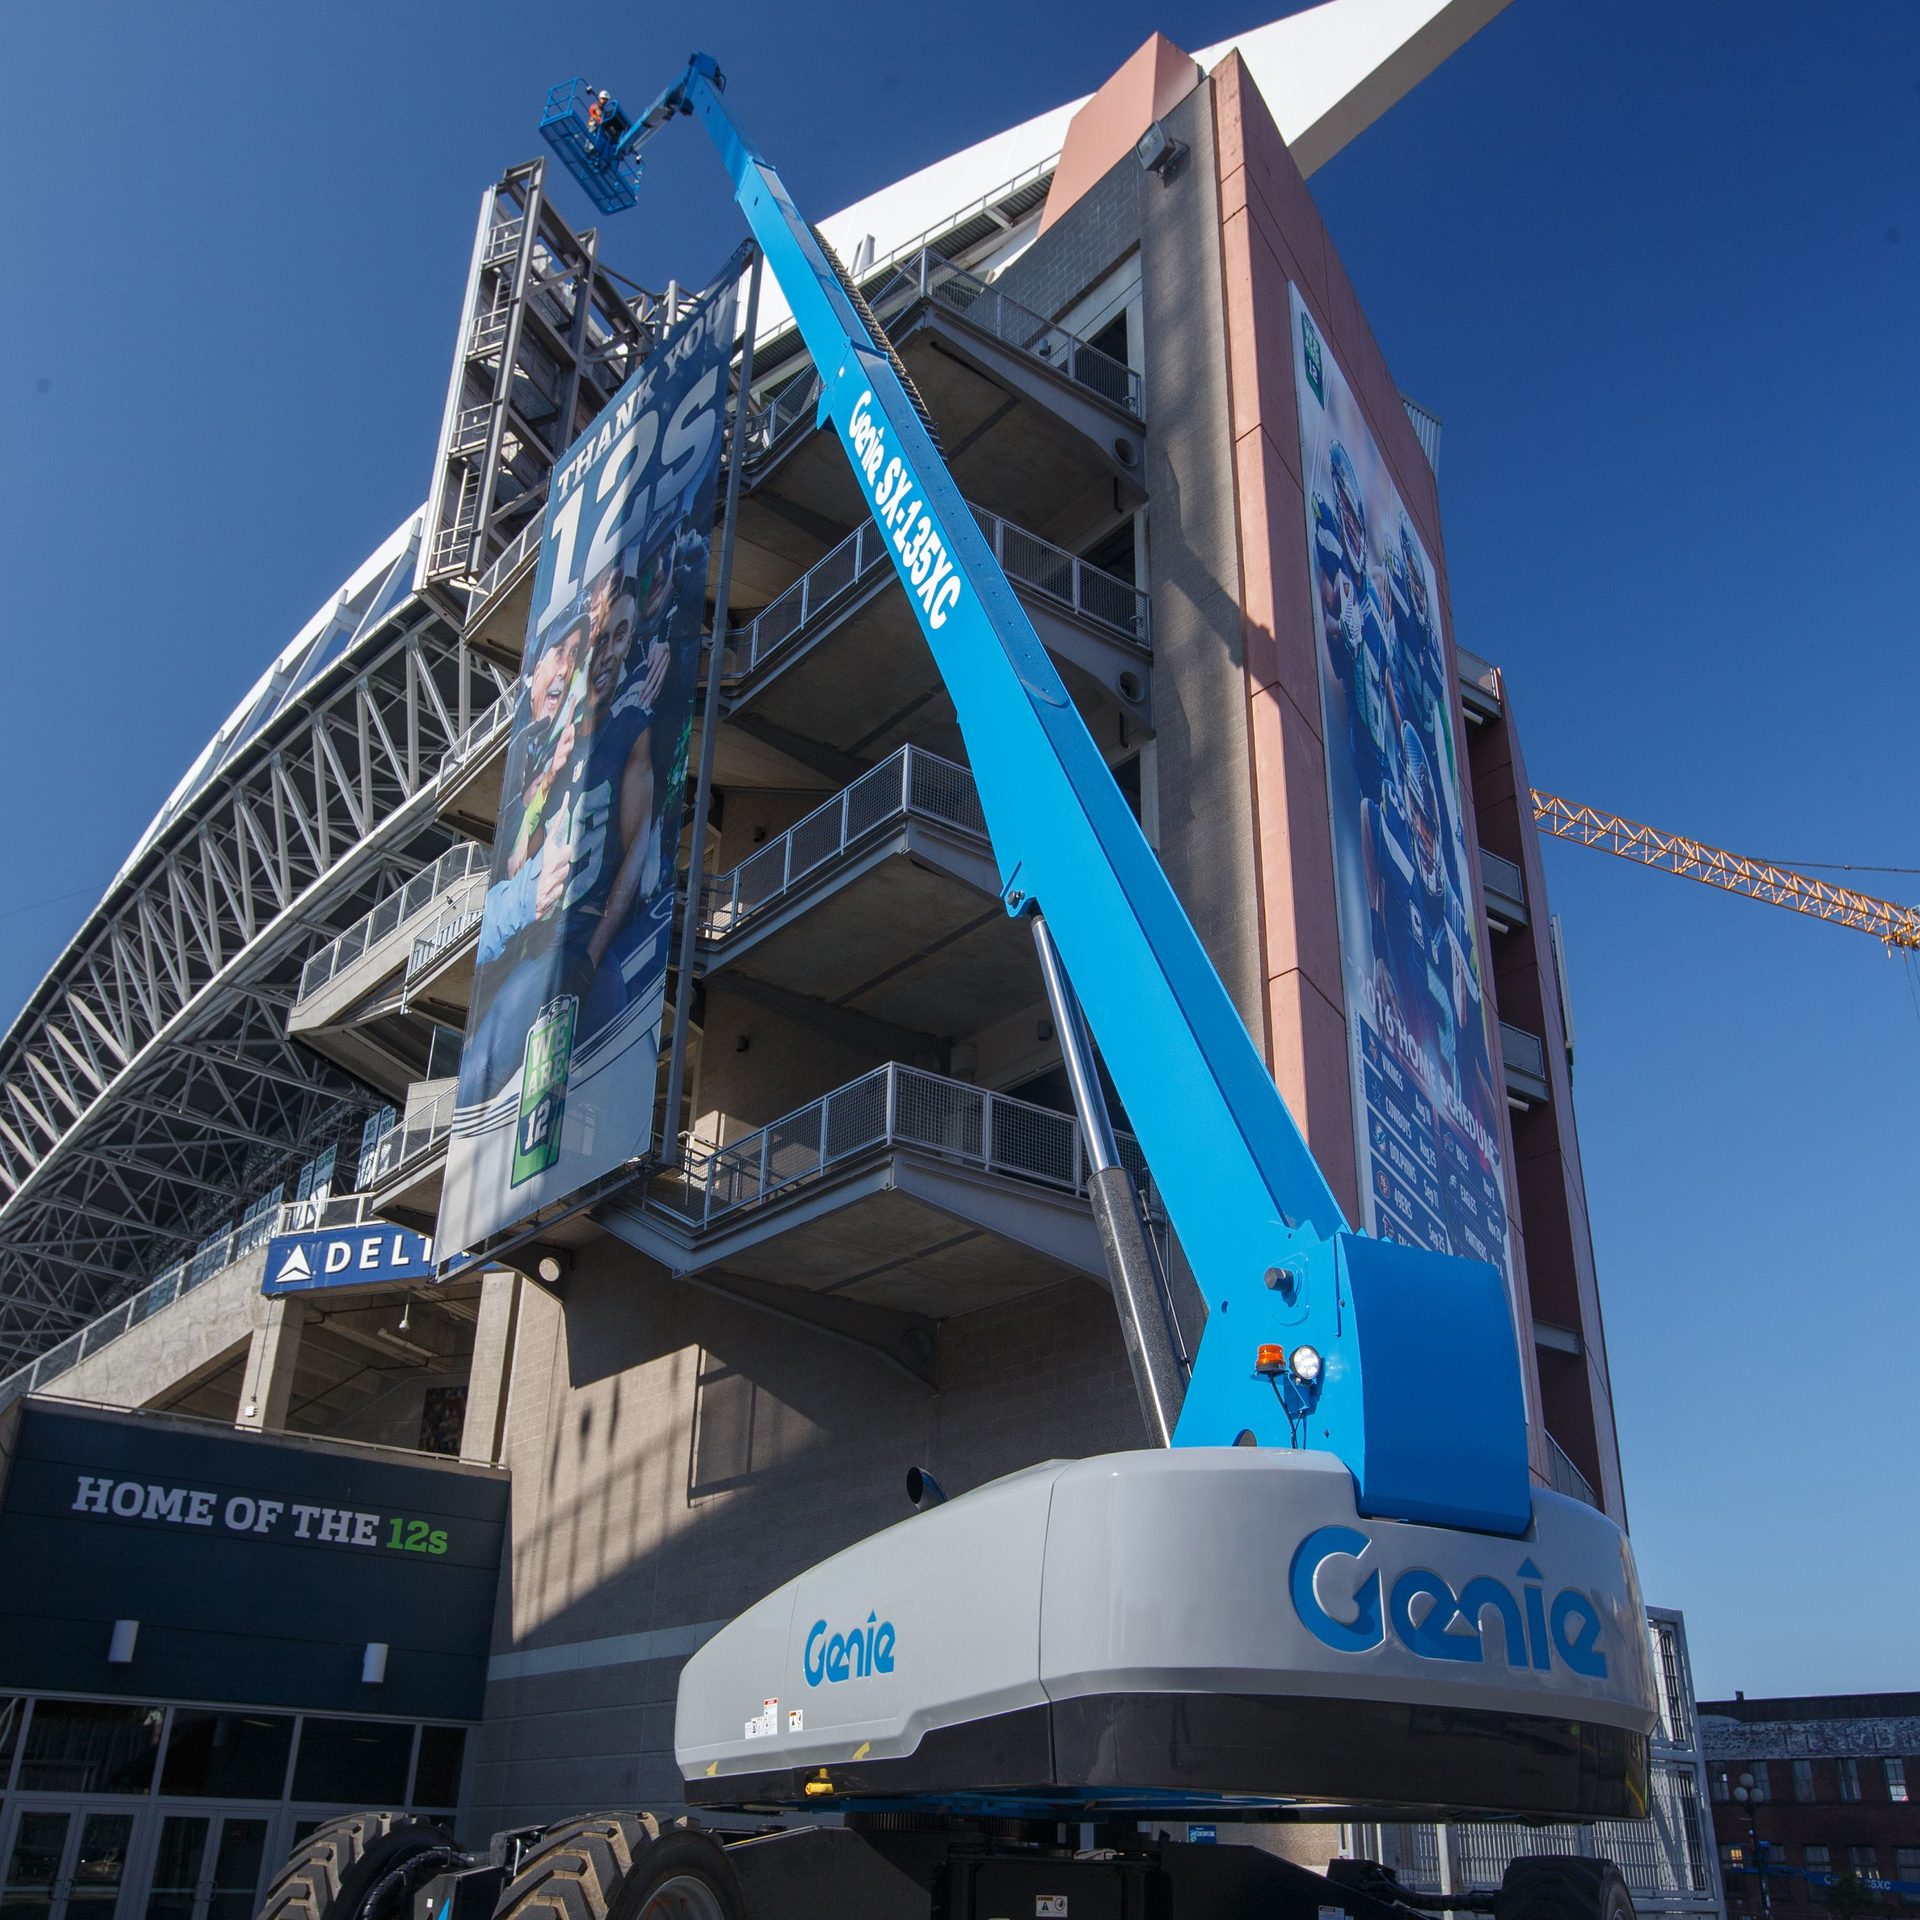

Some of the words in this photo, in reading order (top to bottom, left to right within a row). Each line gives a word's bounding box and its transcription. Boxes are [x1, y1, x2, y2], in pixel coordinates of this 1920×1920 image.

[557, 374, 656, 504] THANK
[663, 284, 733, 381] YOU
[849, 390, 885, 488] Genie
[874, 456, 961, 630] SX-135XC
[530, 1017, 569, 1063] WE
[1353, 1007, 1364, 1094] PRESEASON
[1356, 966, 1394, 1038] 2016
[1397, 1017, 1437, 1092] HOME
[1440, 1077, 1496, 1163] SCHEDULE
[525, 1049, 569, 1097] ARE
[1381, 1051, 1404, 1092] VIKINGS
[524, 1101, 551, 1153] 12
[1385, 1096, 1412, 1140] COWBOYS
[1389, 1140, 1417, 1185] DOLPHINS
[1423, 1178, 1434, 1207] Sep
[1455, 1143, 1469, 1171] BILLS
[1394, 1187, 1413, 1220] 49ERS
[1460, 1183, 1477, 1216] EAGLES
[325, 1233, 433, 1274] DELT
[1464, 1224, 1488, 1263] PANTHERS
[71, 1475, 218, 1527] HOME
[225, 1496, 285, 1534] OF
[291, 1504, 381, 1547] THE
[386, 1517, 449, 1555] 12s
[1289, 1524, 1608, 1680] Genie
[803, 1609, 896, 1688] Genie
